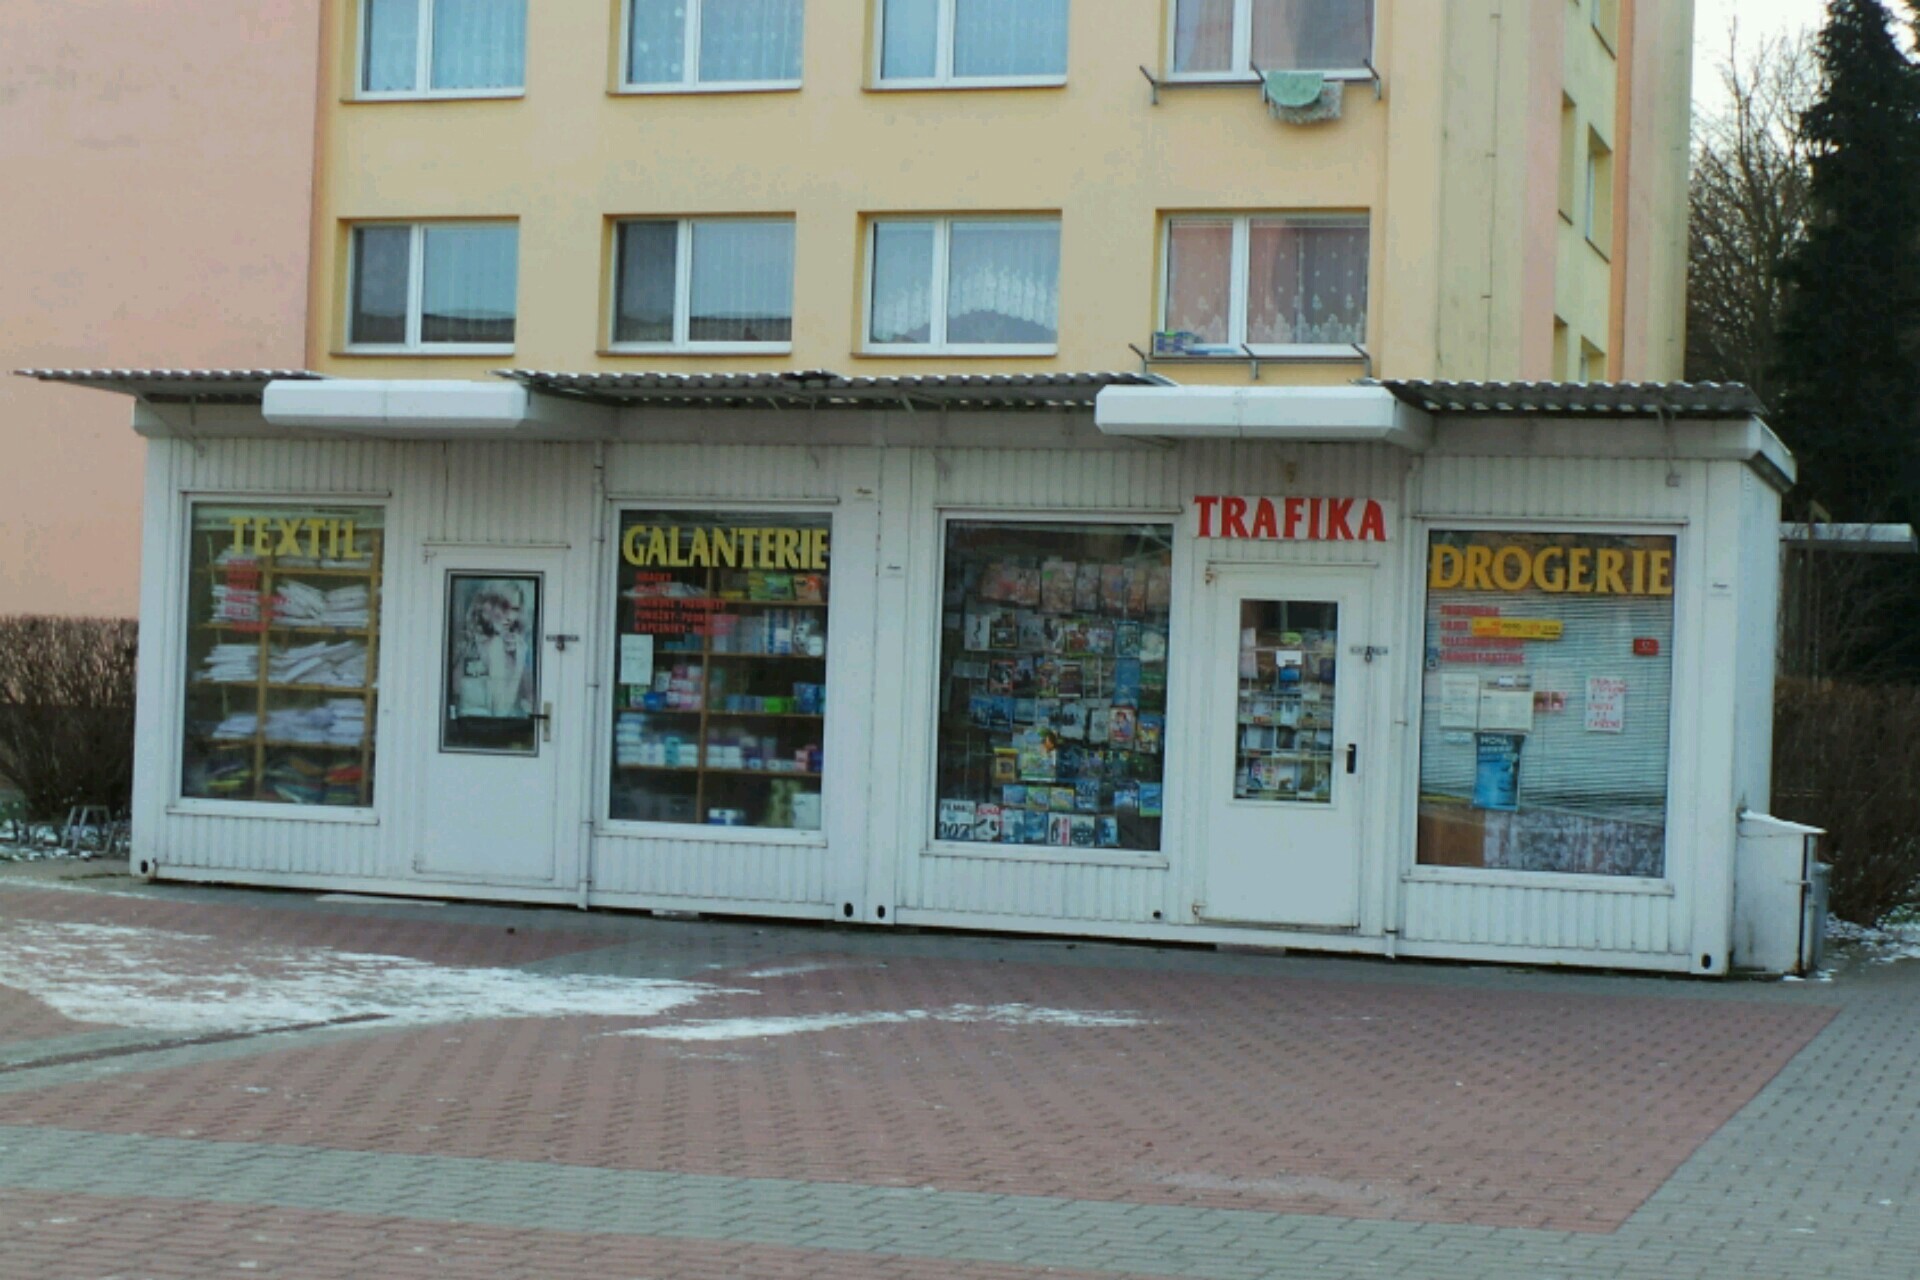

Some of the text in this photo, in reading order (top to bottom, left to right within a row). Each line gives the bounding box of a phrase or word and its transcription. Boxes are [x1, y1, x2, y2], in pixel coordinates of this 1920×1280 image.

[229, 517, 362, 559] TEXTIL
[1193, 495, 1386, 542] TRAFIKA
[623, 525, 829, 570] GALANTERIE
[1429, 543, 1673, 595] DROGERIE
